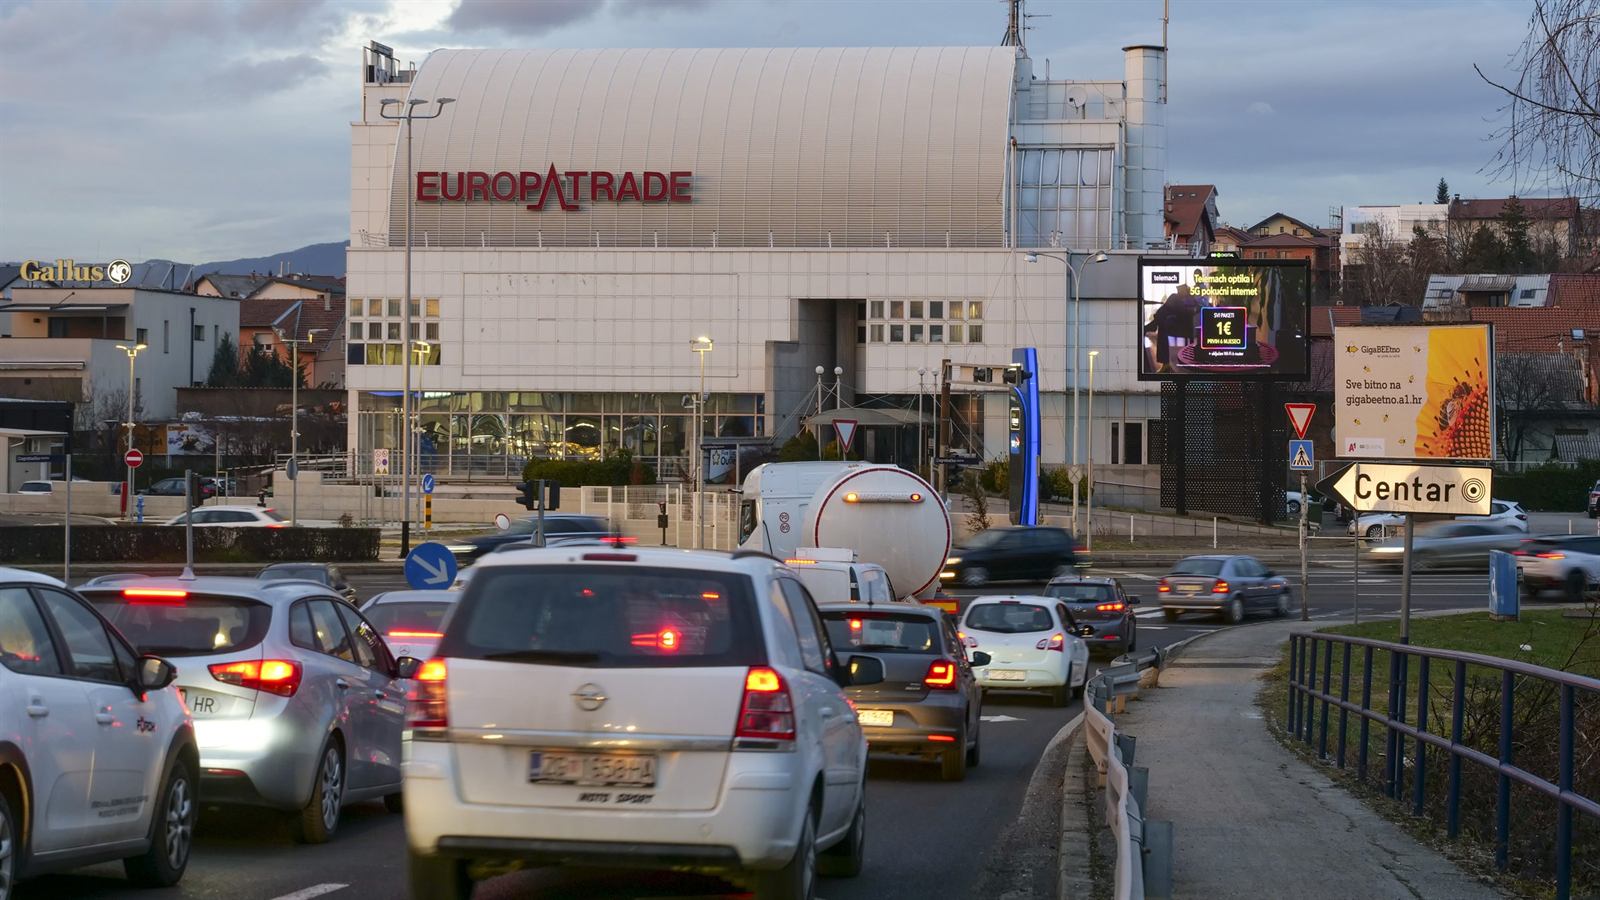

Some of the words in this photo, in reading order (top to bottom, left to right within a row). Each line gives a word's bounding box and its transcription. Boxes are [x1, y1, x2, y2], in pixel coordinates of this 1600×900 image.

[417, 162, 692, 211] EUROPATRADE
[20, 259, 104, 282] Gallus
[1195, 274, 1227, 283] Telemach
[1228, 274, 1250, 285] optika
[1190, 287, 1200, 295] 5G
[1201, 286, 1229, 297] pokućni
[1230, 286, 1258, 296] internet
[1216, 321, 1232, 336] 1€
[1361, 345, 1400, 355] GigaBEEtno
[1346, 379, 1362, 389] Sve
[1364, 380, 1388, 389] bitno
[1346, 394, 1422, 406] gigabeetno.a1.hr
[1356, 473, 1455, 502] Centar
[193, 696, 215, 713] HR
